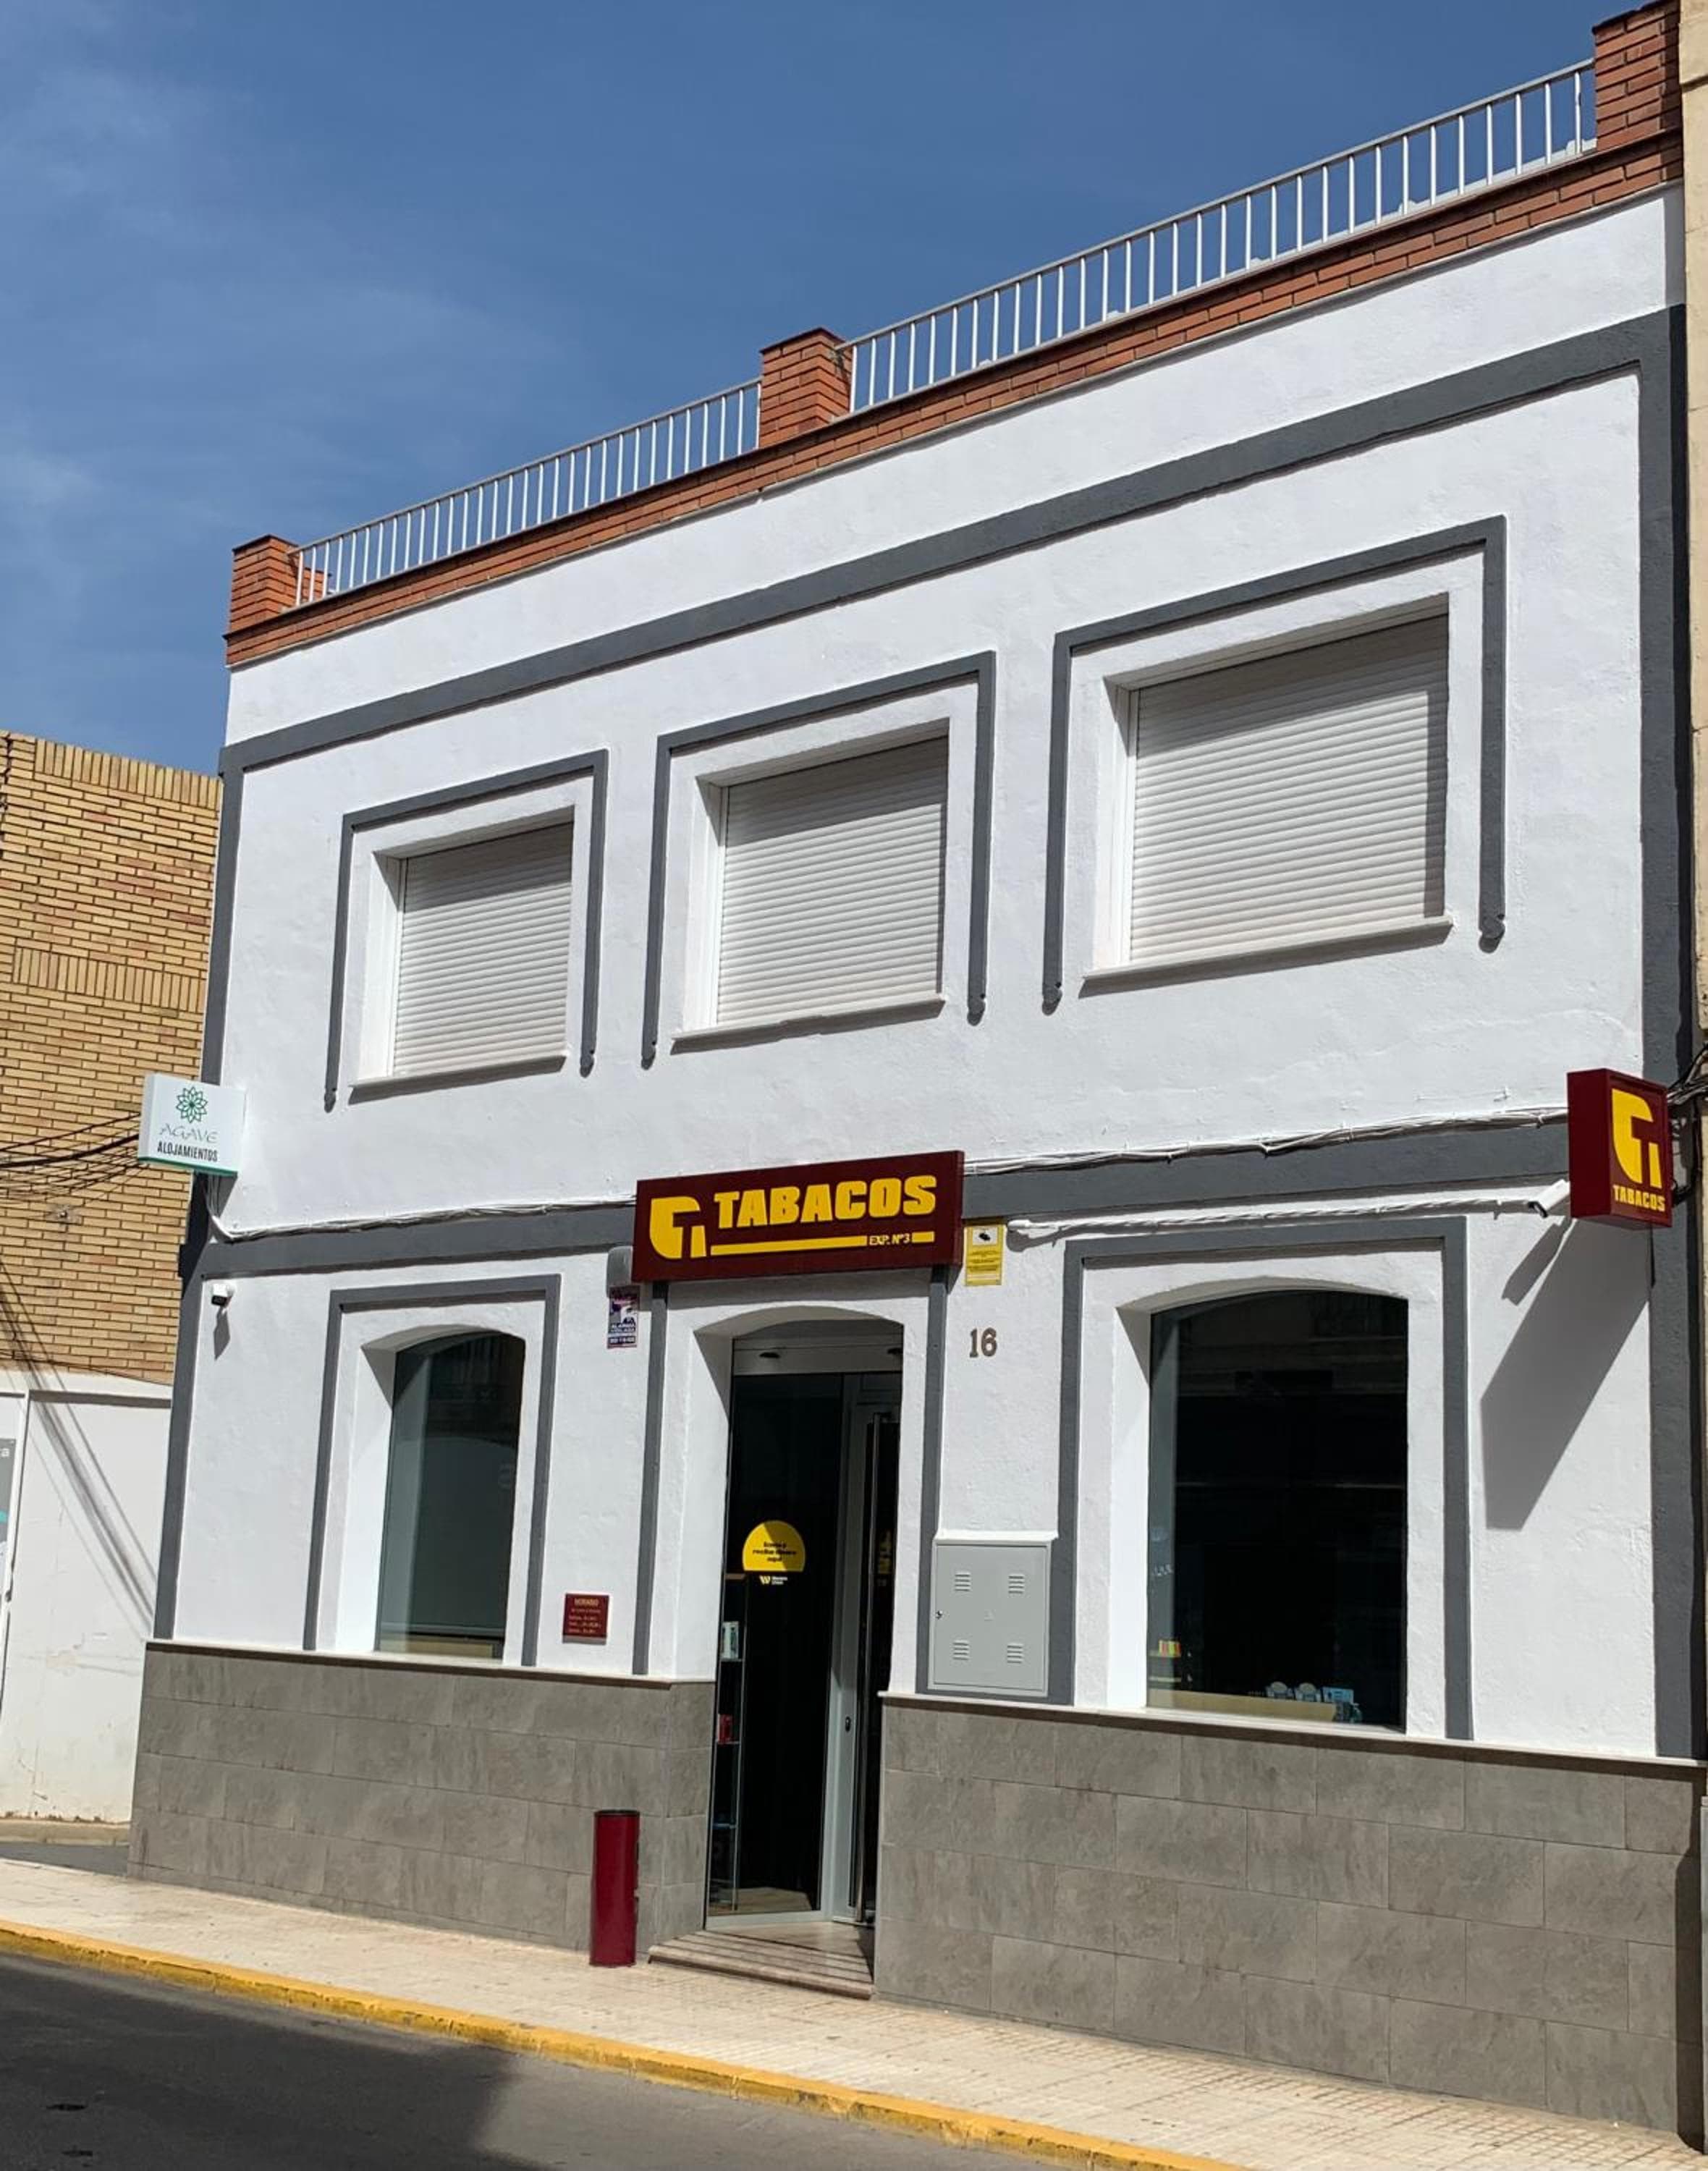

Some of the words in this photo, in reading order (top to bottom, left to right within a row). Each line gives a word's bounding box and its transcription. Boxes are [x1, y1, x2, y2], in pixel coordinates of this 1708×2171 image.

[159, 1123, 219, 1143] AGAVE
[157, 1140, 218, 1162] ALOJAMIENTOS
[714, 1175, 937, 1229] TABACOS
[1612, 1184, 1665, 1212] TABACOS
[869, 1234, 891, 1245] EXP.
[969, 1327, 997, 1358] 16
